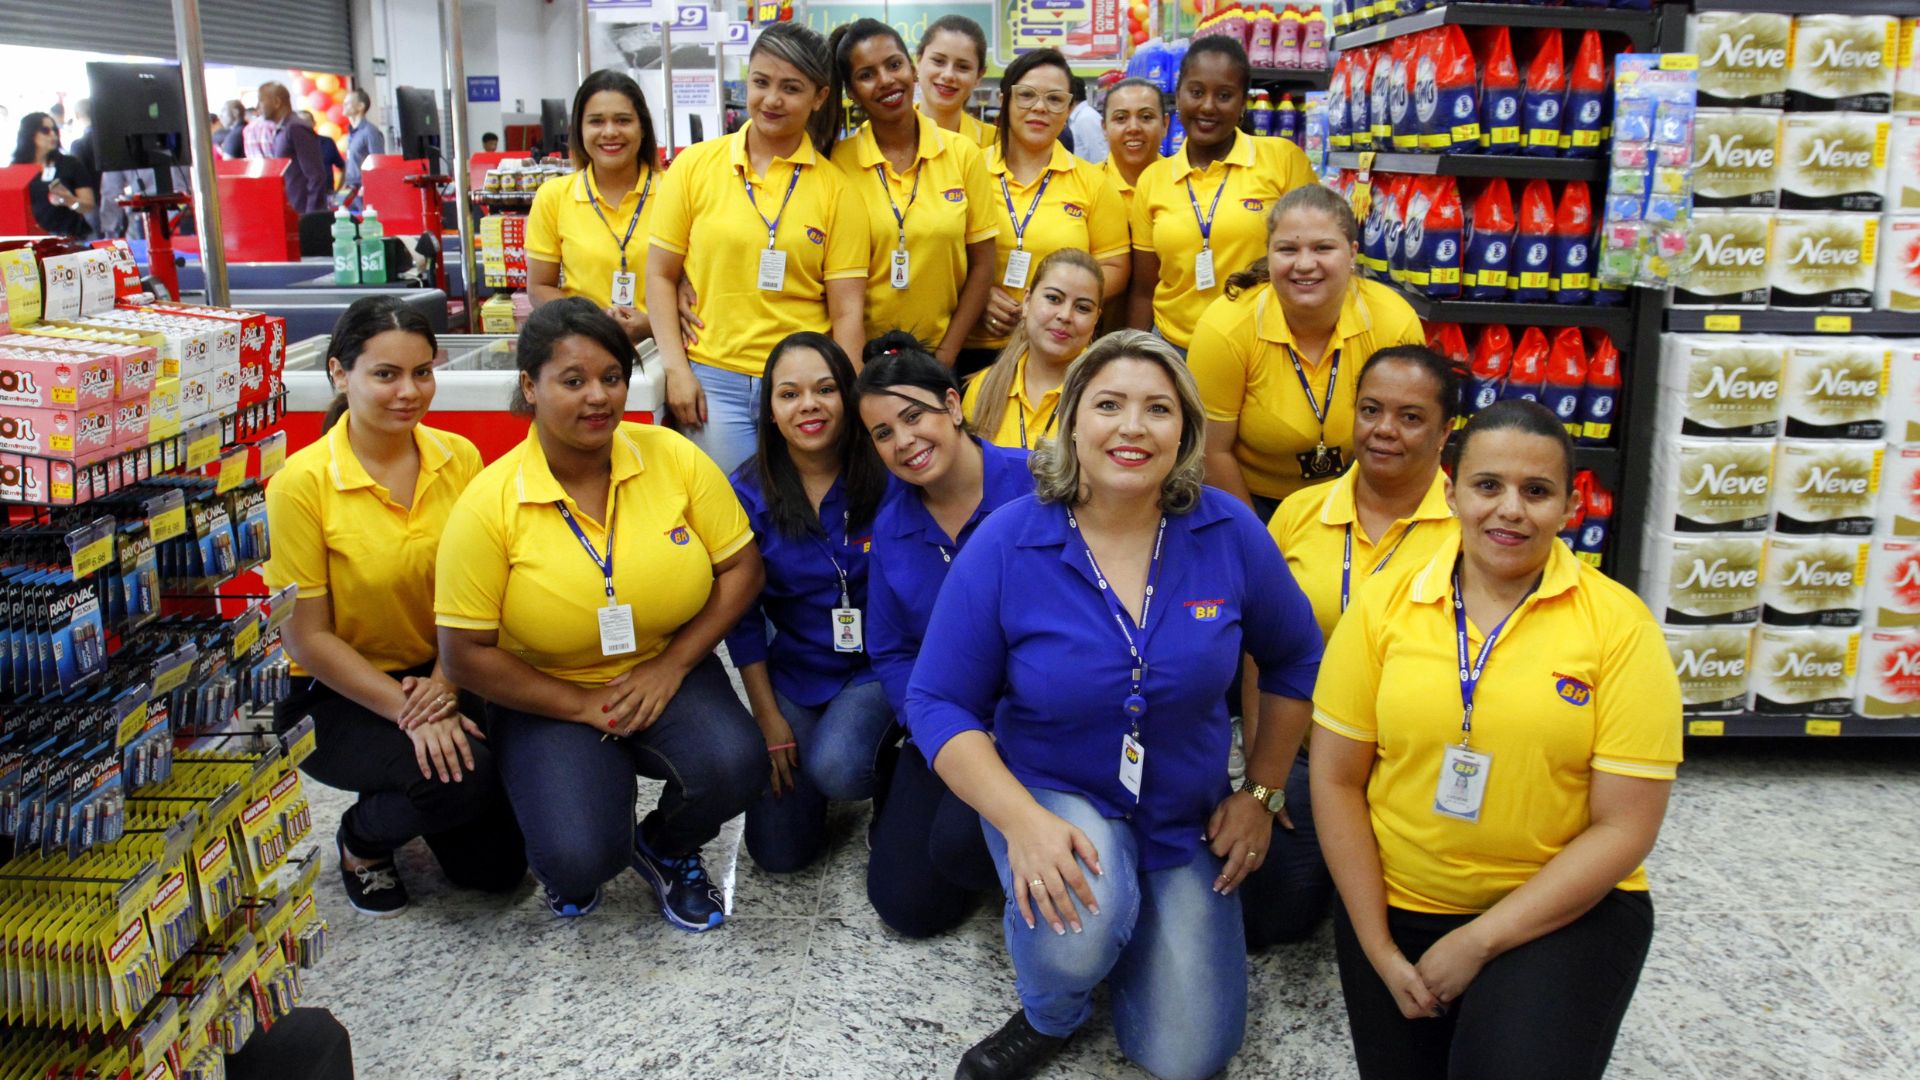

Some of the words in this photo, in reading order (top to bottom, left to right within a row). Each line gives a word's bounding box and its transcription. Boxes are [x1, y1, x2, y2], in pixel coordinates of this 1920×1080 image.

[759, 5, 777, 21] BH
[1096, 0, 1105, 32] CONSU
[1701, 32, 1786, 69] Neve
[1810, 39, 1881, 68] Neve
[1692, 134, 1774, 168] Neve
[1800, 139, 1871, 168] Neve
[1690, 234, 1765, 265] Neve
[1789, 237, 1859, 264] Neve
[81, 367, 114, 389] Baton
[126, 359, 156, 379] Baton
[1693, 366, 1778, 399] Neve
[1805, 368, 1877, 396] Neve
[80, 413, 112, 436] Baton
[119, 404, 149, 424] Baton
[1685, 463, 1768, 495] Neve
[1795, 466, 1867, 494] Neve
[195, 502, 226, 527] RAYOVAC
[121, 537, 151, 563] RAYOVA
[674, 531, 687, 543] BH
[1676, 558, 1758, 589] Neve
[1782, 560, 1852, 586] Neve
[50, 584, 95, 618] RAYOVAC
[1195, 605, 1218, 619] BH
[250, 628, 281, 656] RAYOVAC
[1677, 649, 1744, 677] Neve
[1773, 652, 1842, 677] Neve
[1560, 683, 1588, 702] BH
[1126, 748, 1138, 763] BH
[1455, 763, 1476, 775] BH
[74, 752, 120, 791] RAYOVAC
[201, 837, 227, 870] RAYOVAC
[152, 873, 184, 909] RAYOVAC
[111, 918, 142, 961] RAYOVAC
